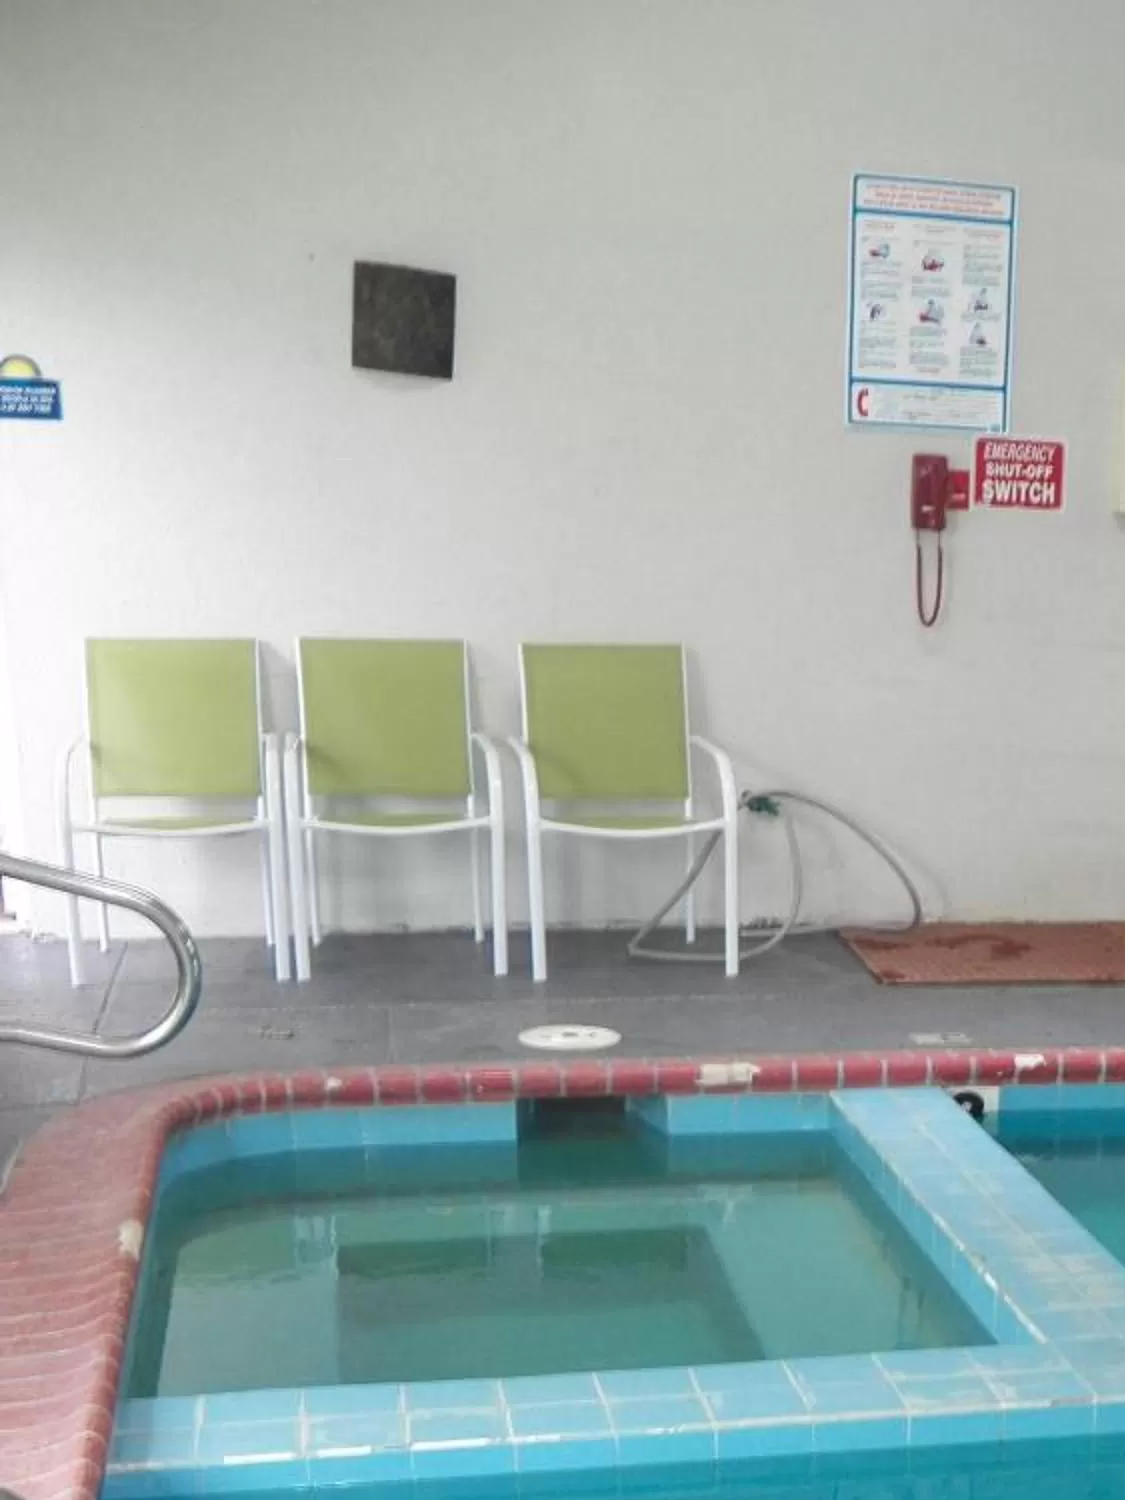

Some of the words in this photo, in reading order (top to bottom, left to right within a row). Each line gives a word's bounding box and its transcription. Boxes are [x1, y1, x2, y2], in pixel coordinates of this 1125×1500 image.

[984, 441, 1056, 462] EMERGENCY
[986, 462, 1055, 479] SHUT-OFF
[982, 480, 1055, 504] SWITCH
